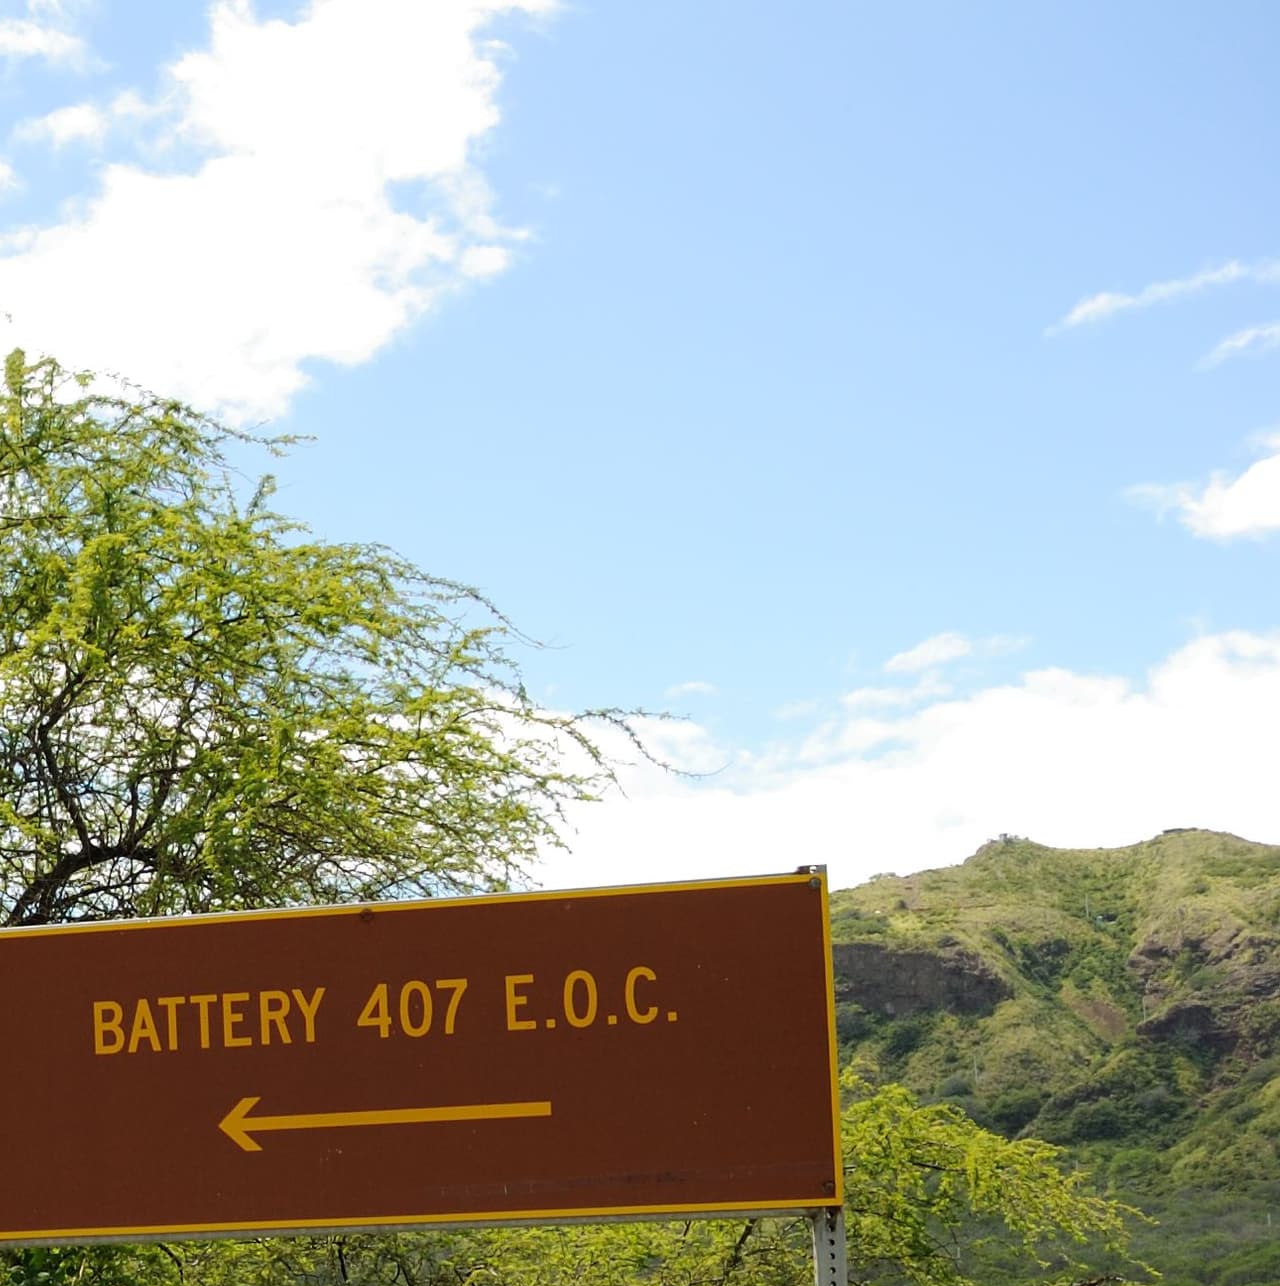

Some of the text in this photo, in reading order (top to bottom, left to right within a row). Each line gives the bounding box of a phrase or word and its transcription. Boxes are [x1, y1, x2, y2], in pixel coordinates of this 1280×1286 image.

[94, 967, 676, 1054] BATTERY 407 E.O.C.
